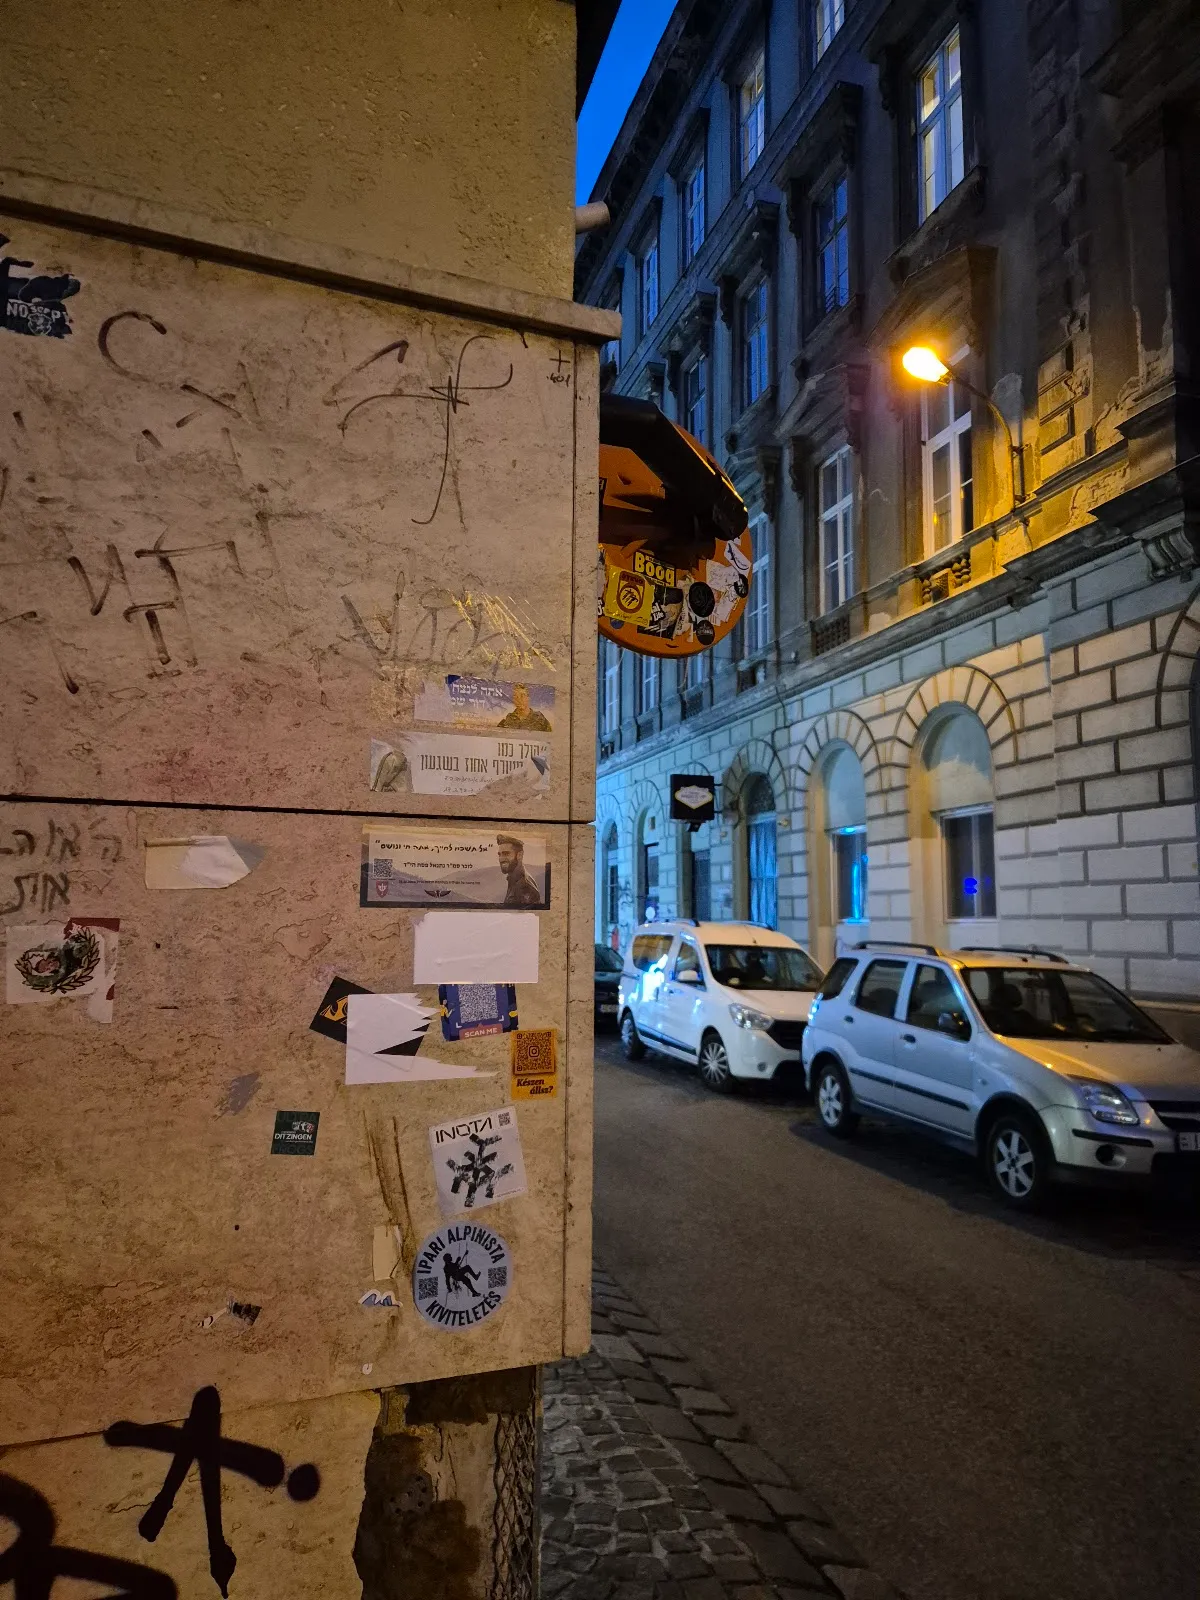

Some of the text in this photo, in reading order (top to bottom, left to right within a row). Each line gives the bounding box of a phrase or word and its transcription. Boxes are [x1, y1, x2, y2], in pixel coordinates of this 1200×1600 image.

[635, 551, 676, 588] Boog
[497, 743, 514, 757] כמו
[420, 754, 460, 772] בשגעון
[464, 757, 488, 773] אחוז
[464, 1027, 498, 1038] SCAN ME
[517, 1078, 544, 1087] Készen
[530, 1086, 554, 1094] állsz?
[436, 1117, 493, 1143] INOTA
[417, 1226, 506, 1274] IPARI ALPINISTA
[426, 1291, 502, 1326] KIVITELEZÉS
